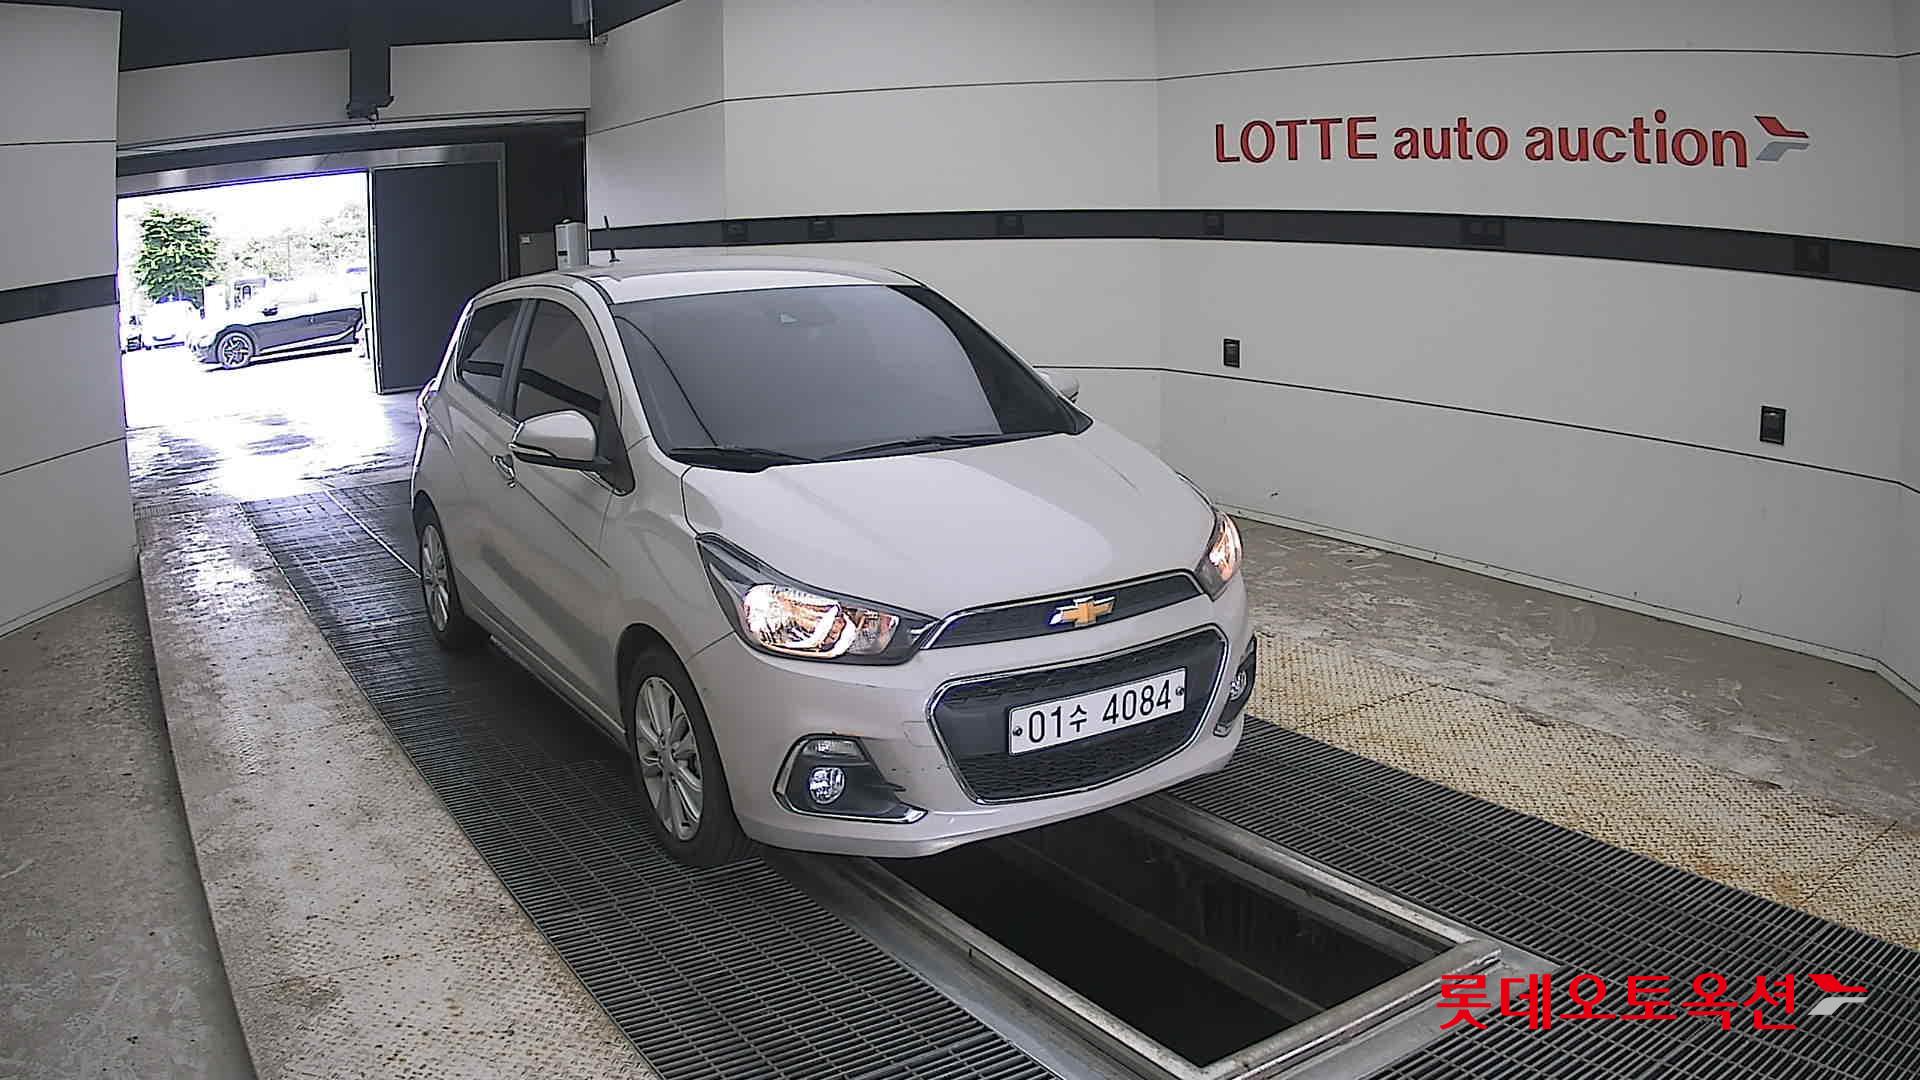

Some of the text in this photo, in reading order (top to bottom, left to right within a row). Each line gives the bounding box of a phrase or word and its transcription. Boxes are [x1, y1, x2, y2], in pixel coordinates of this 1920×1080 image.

[1215, 109, 1748, 168] LOTTE auto auction
[1029, 679, 1171, 743] 01수 4084
